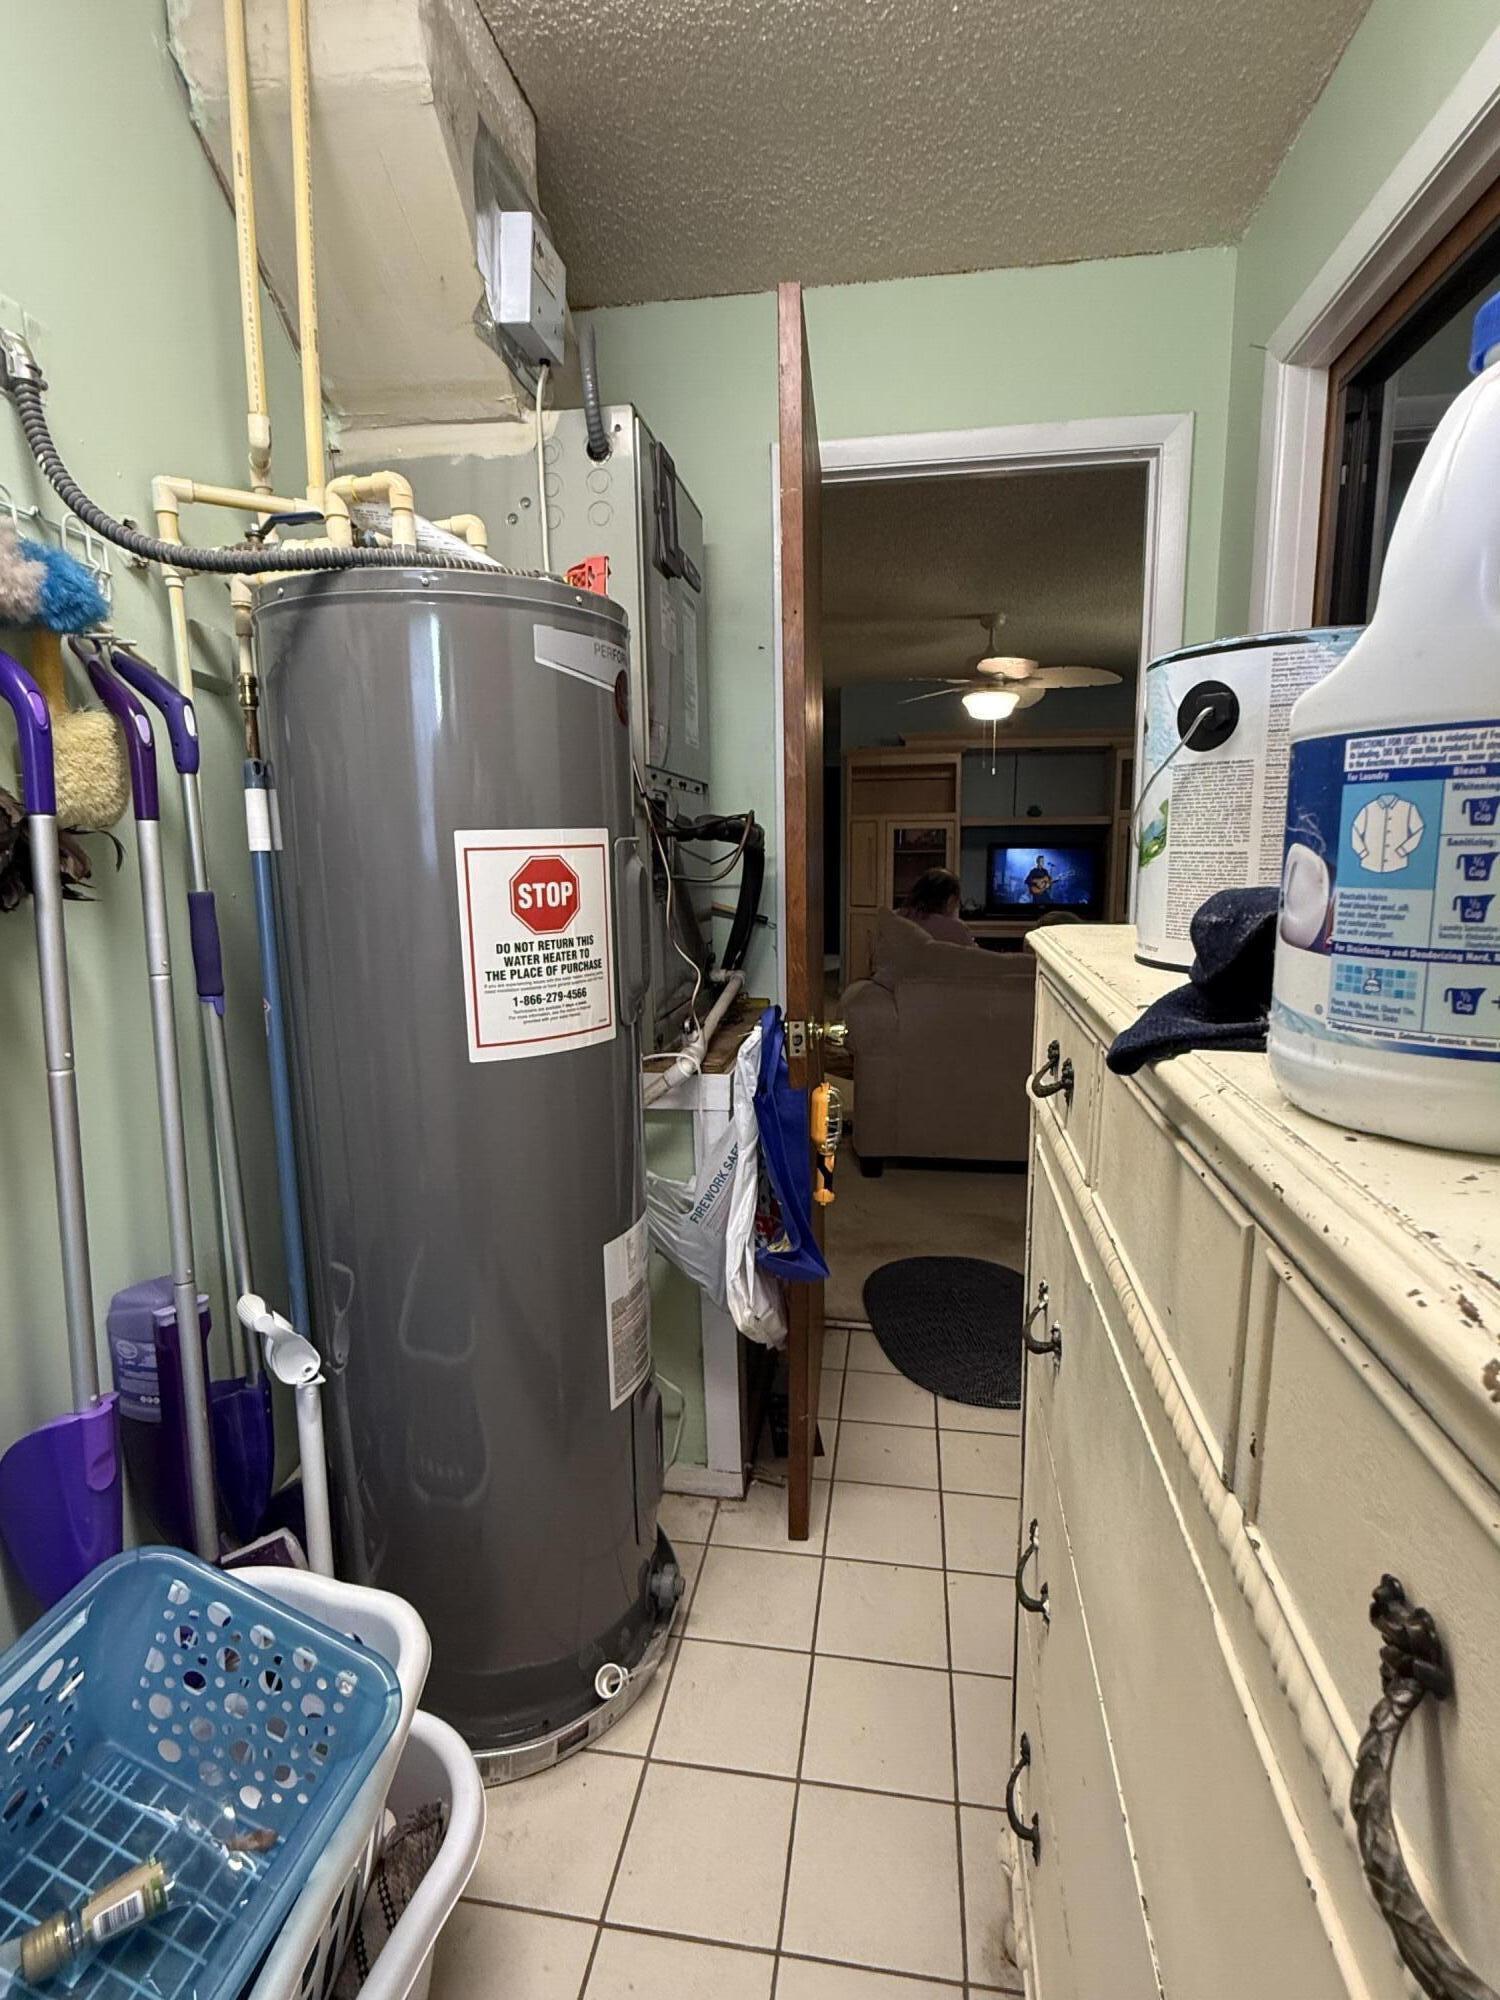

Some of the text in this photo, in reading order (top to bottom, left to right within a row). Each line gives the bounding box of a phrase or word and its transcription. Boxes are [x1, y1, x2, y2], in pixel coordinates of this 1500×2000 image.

[1360, 770, 1390, 781] Laundry
[1453, 766, 1486, 776] Bleach
[1474, 812, 1492, 823] Cup
[1468, 866, 1486, 878] Cup
[518, 882, 573, 909] STOP
[1464, 908, 1482, 920] Cup
[496, 934, 594, 954] DO NOT RETURN THIS
[1346, 944, 1390, 958] Disinfecting
[1391, 949, 1408, 958] and
[1410, 950, 1464, 962] Deodorizing
[504, 948, 590, 968] WATER HEATER TO
[484, 970, 506, 982] THE
[510, 966, 542, 980] PLACE
[546, 964, 558, 976] OF
[561, 958, 602, 976] PURCHASE
[512, 987, 587, 1008] 1-866-279-4566
[1456, 1000, 1474, 1012] Cup
[690, 1170, 729, 1224] FIREWORK
[723, 1142, 738, 1171] SAF
